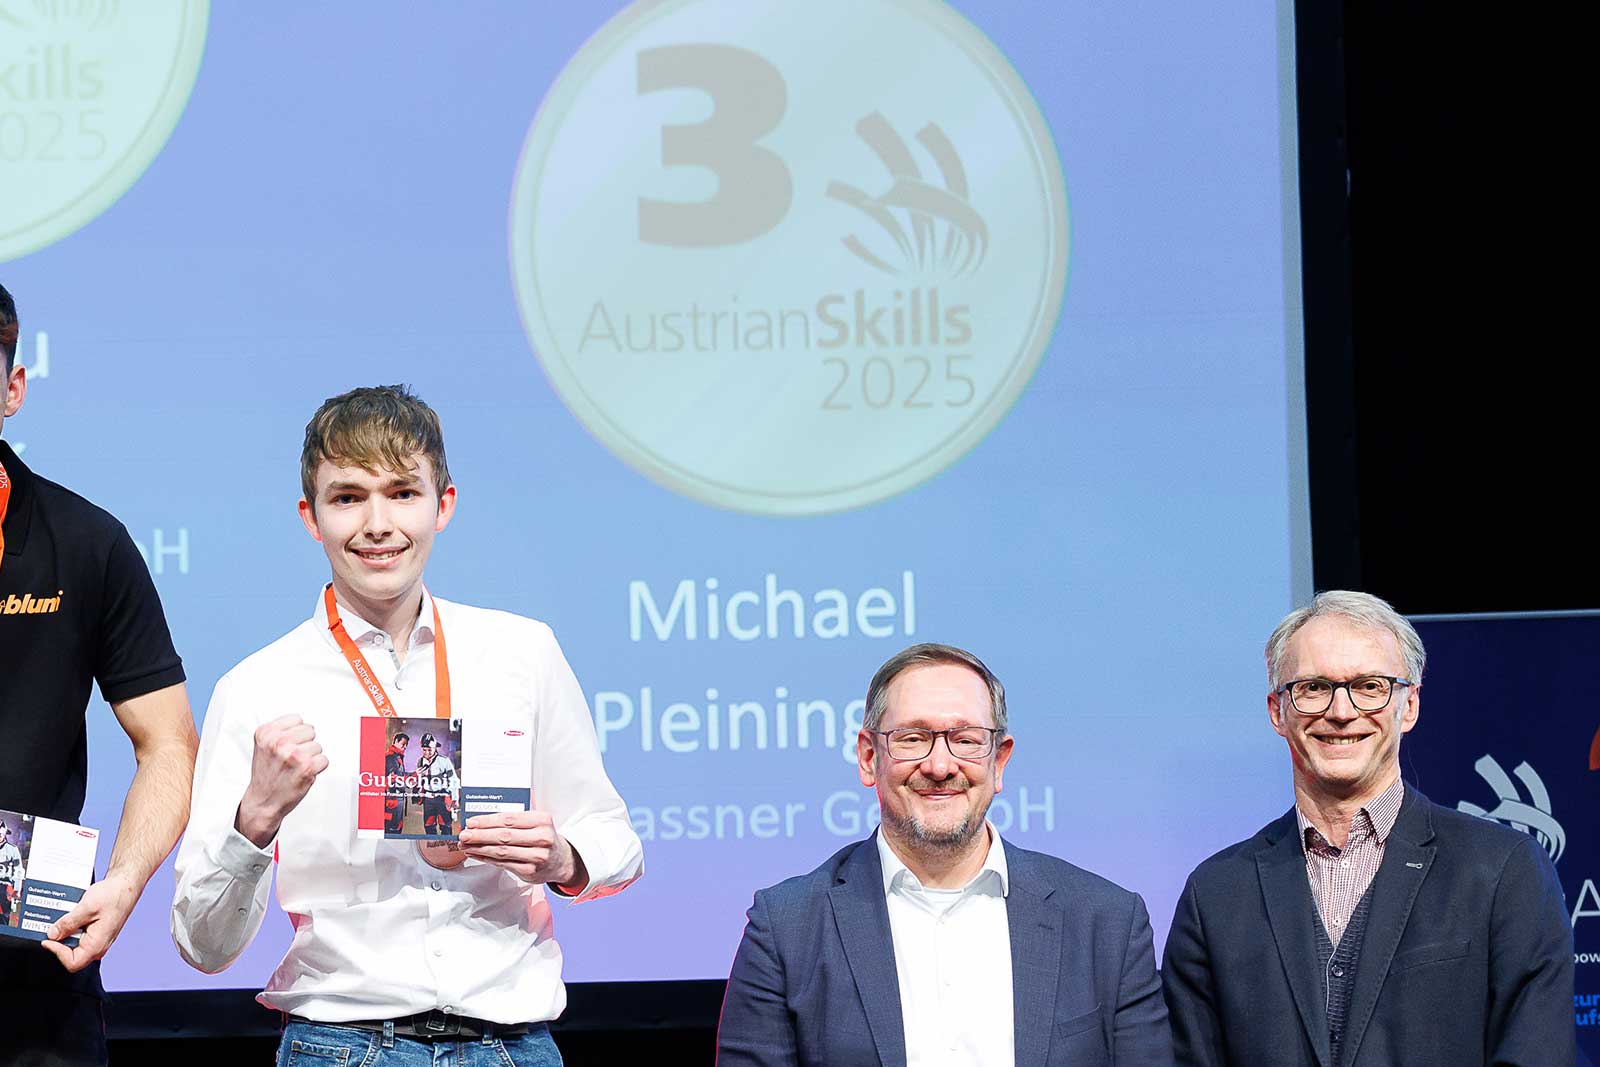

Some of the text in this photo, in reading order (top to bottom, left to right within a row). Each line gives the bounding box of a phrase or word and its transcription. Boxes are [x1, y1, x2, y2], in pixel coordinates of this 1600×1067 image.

[636, 42, 794, 248] 3
[578, 287, 973, 354] AustrianSkills
[820, 354, 977, 411] 2025
[629, 571, 918, 642] Michael
